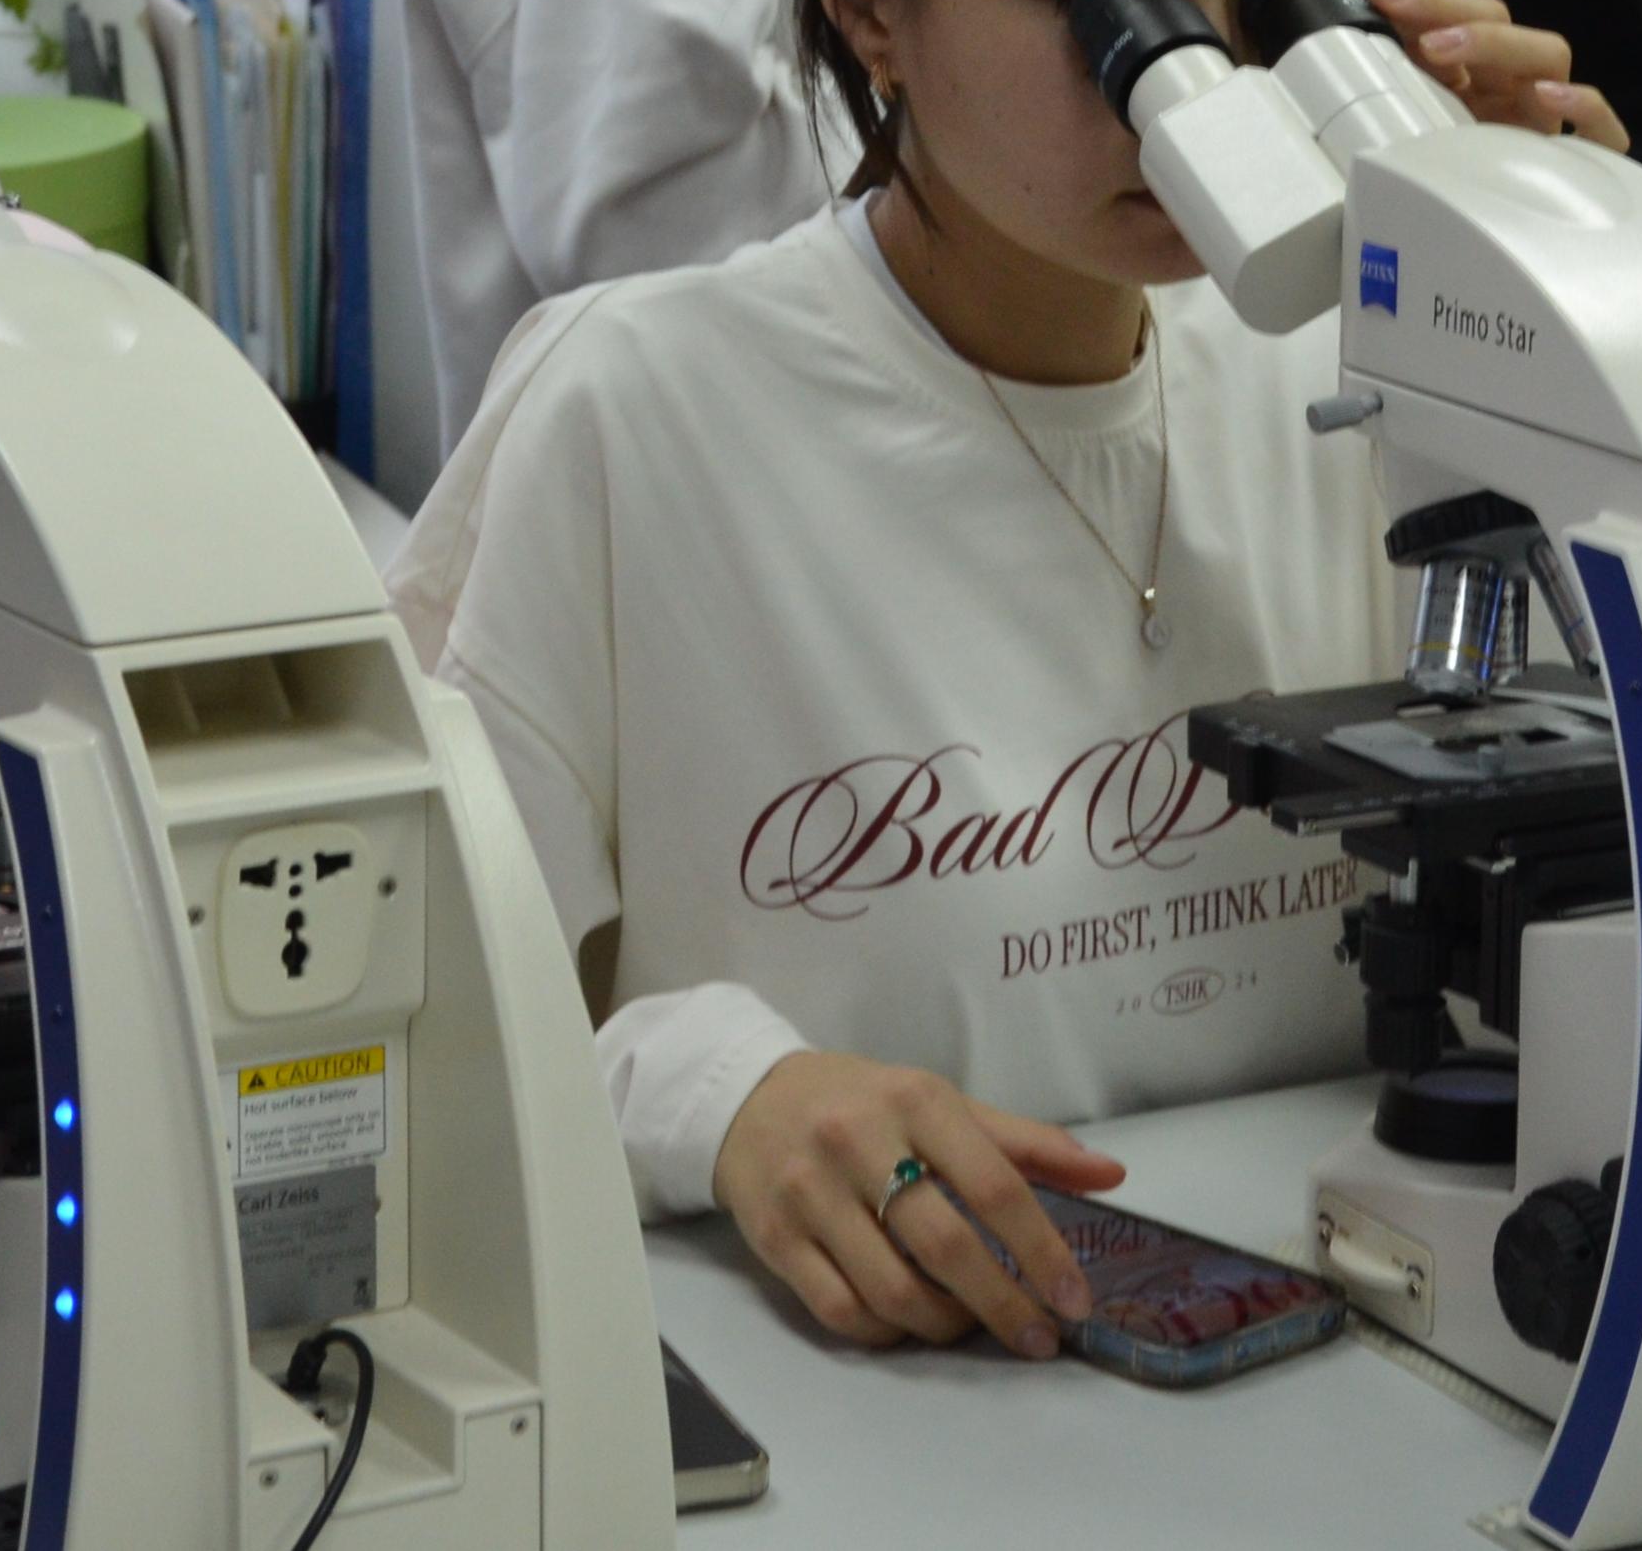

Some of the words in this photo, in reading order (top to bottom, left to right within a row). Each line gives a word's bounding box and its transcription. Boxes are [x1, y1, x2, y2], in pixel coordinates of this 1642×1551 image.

[1361, 260, 1396, 284] ZEISS
[1433, 294, 1489, 342] Primo
[1495, 311, 1537, 355] Star
[740, 738, 1129, 921] Bad
[1001, 930, 1052, 980] DO
[1060, 904, 1157, 968] FIRST,
[1166, 877, 1269, 941] THINK
[275, 1052, 370, 1087] CAUTION
[244, 1102, 267, 1118] Hot
[270, 1093, 316, 1113] surface
[319, 1087, 358, 1105] below
[238, 1192, 273, 1215] Carl
[276, 1185, 321, 1210] Zeiss
